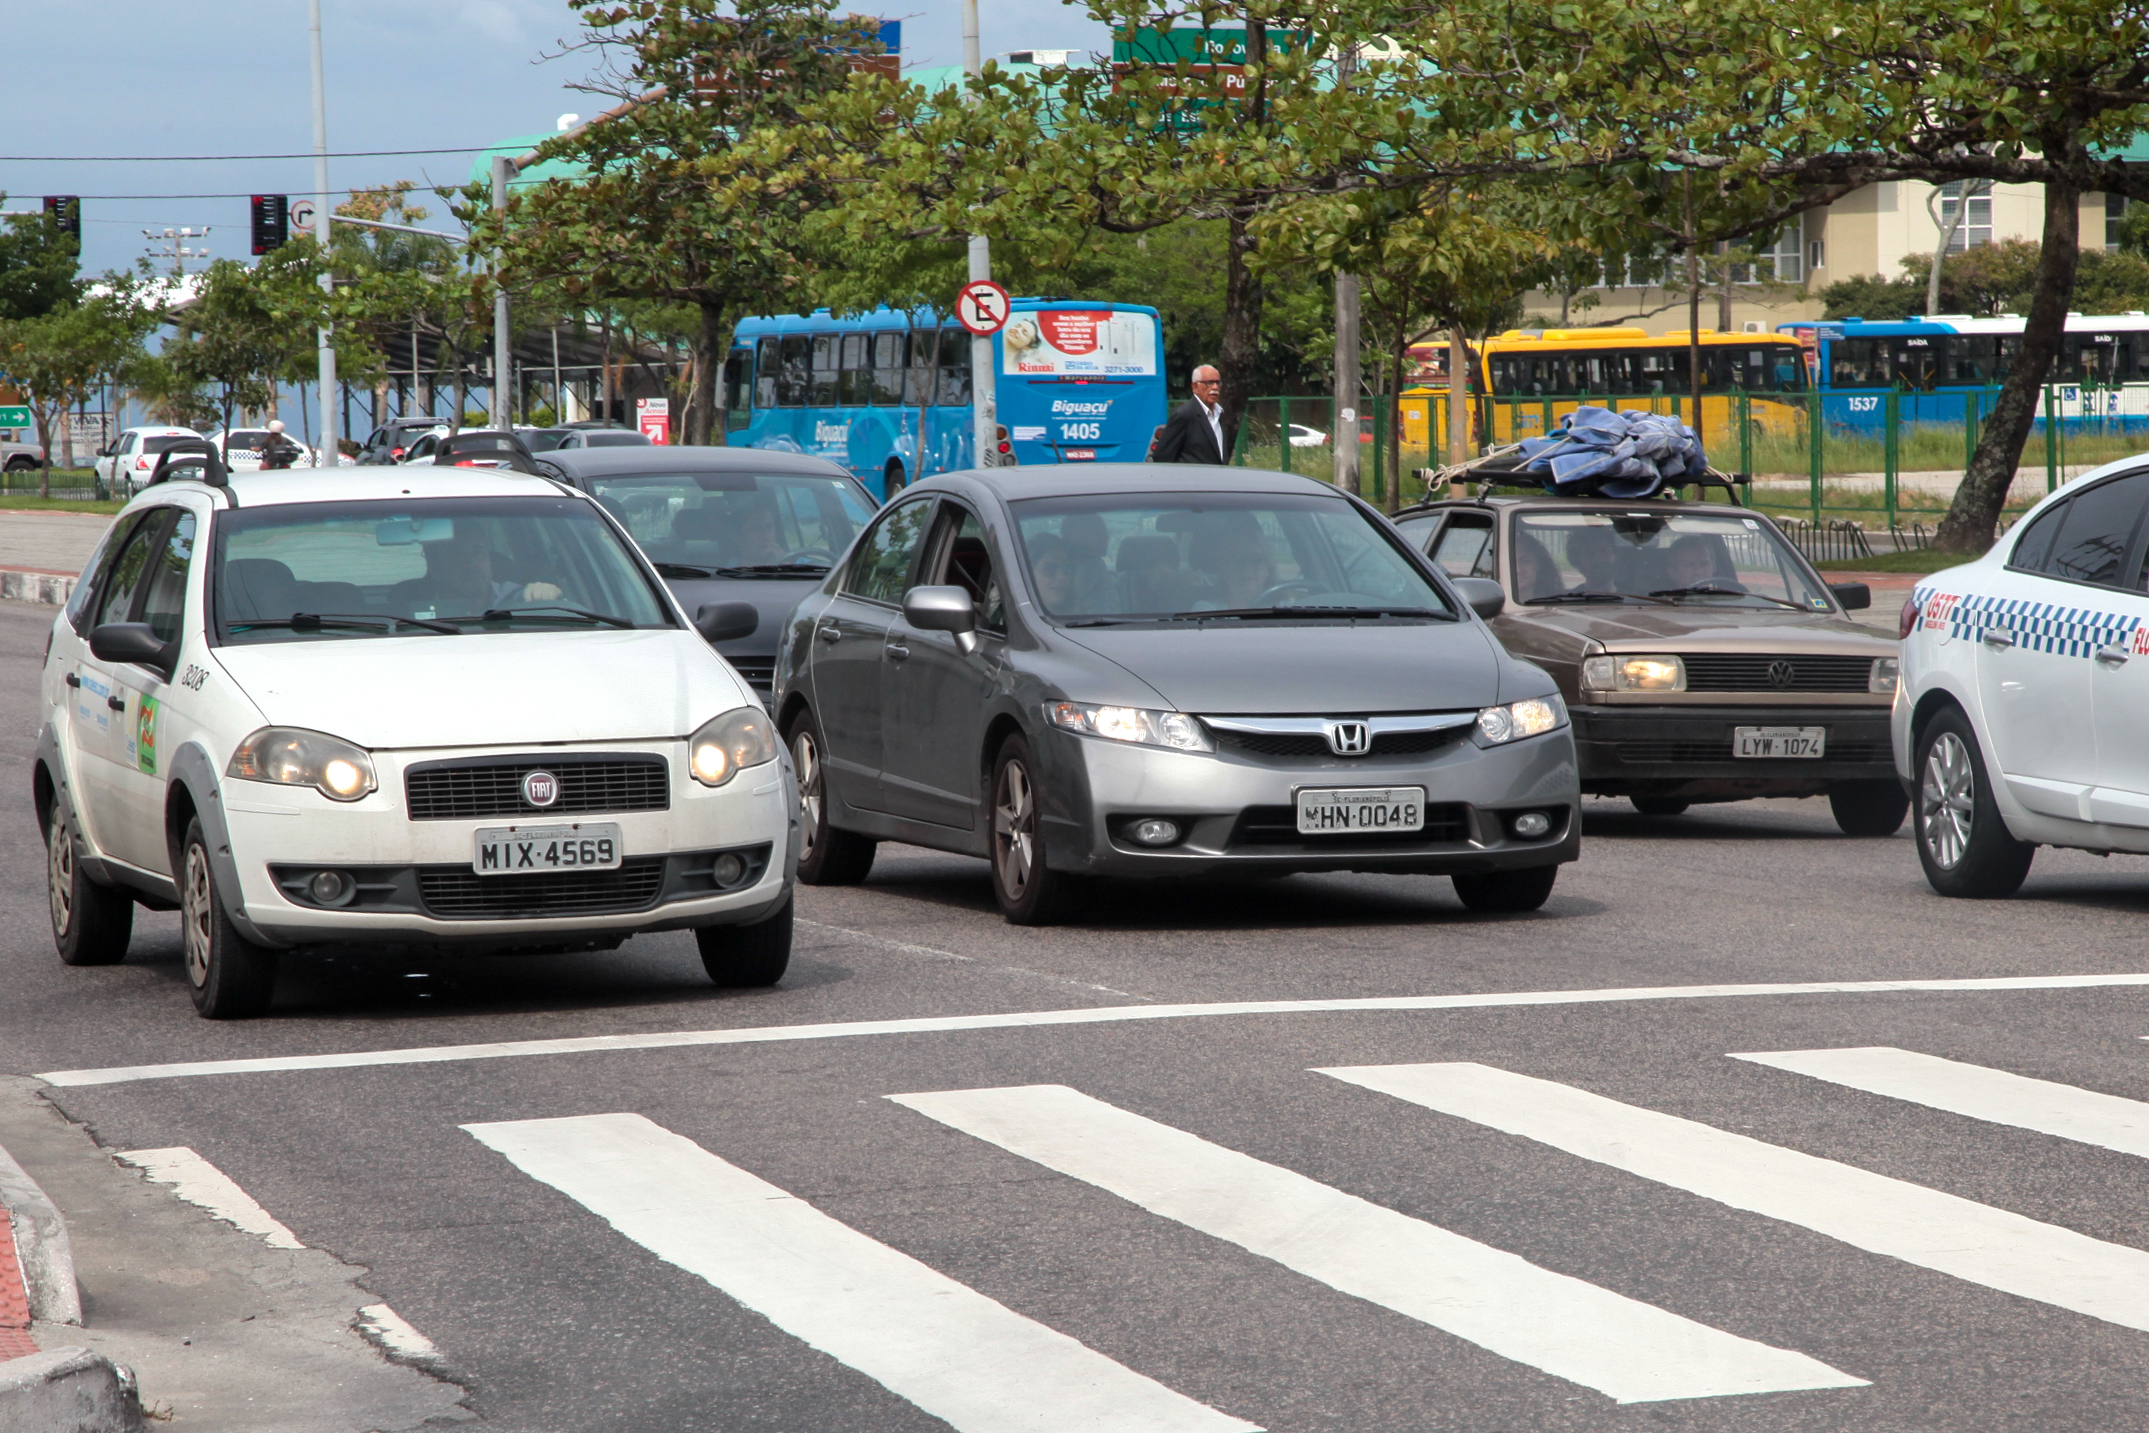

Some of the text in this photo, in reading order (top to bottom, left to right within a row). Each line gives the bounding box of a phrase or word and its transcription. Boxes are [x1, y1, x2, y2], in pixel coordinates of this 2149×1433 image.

[1018, 362, 1055, 372] Rinnai
[1051, 400, 1108, 415] Biguaçu
[1848, 397, 1878, 411] 1537
[1060, 423, 1100, 440] 1405
[1927, 592, 1959, 620] 0577
[531, 782, 550, 798] FIAT
